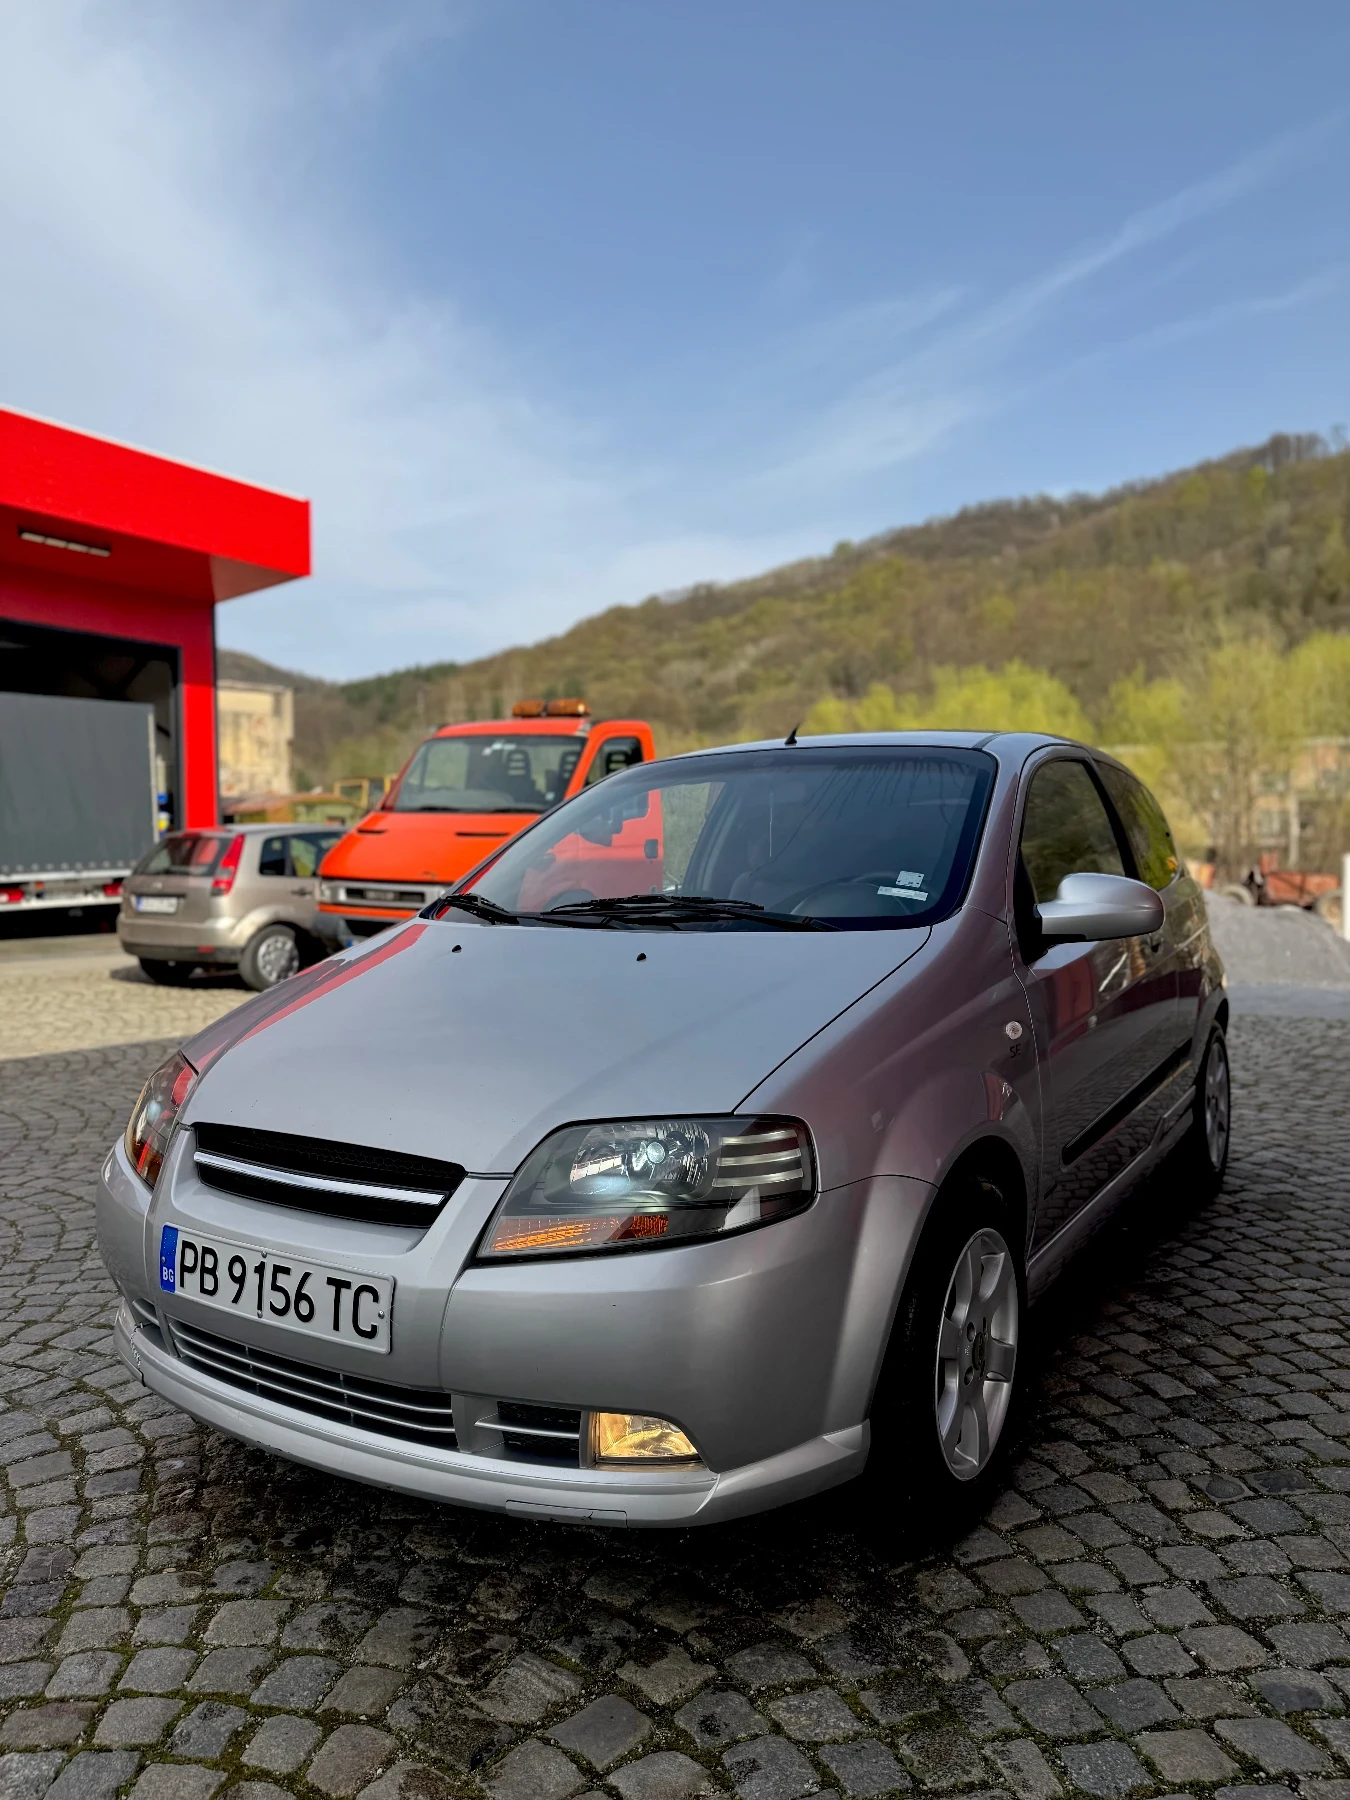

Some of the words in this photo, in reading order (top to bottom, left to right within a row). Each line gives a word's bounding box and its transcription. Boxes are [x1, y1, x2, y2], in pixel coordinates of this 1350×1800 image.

[162, 1266, 175, 1283] BG
[179, 1239, 218, 1297] PB
[228, 1254, 315, 1323] 9156
[326, 1276, 379, 1340] TC
